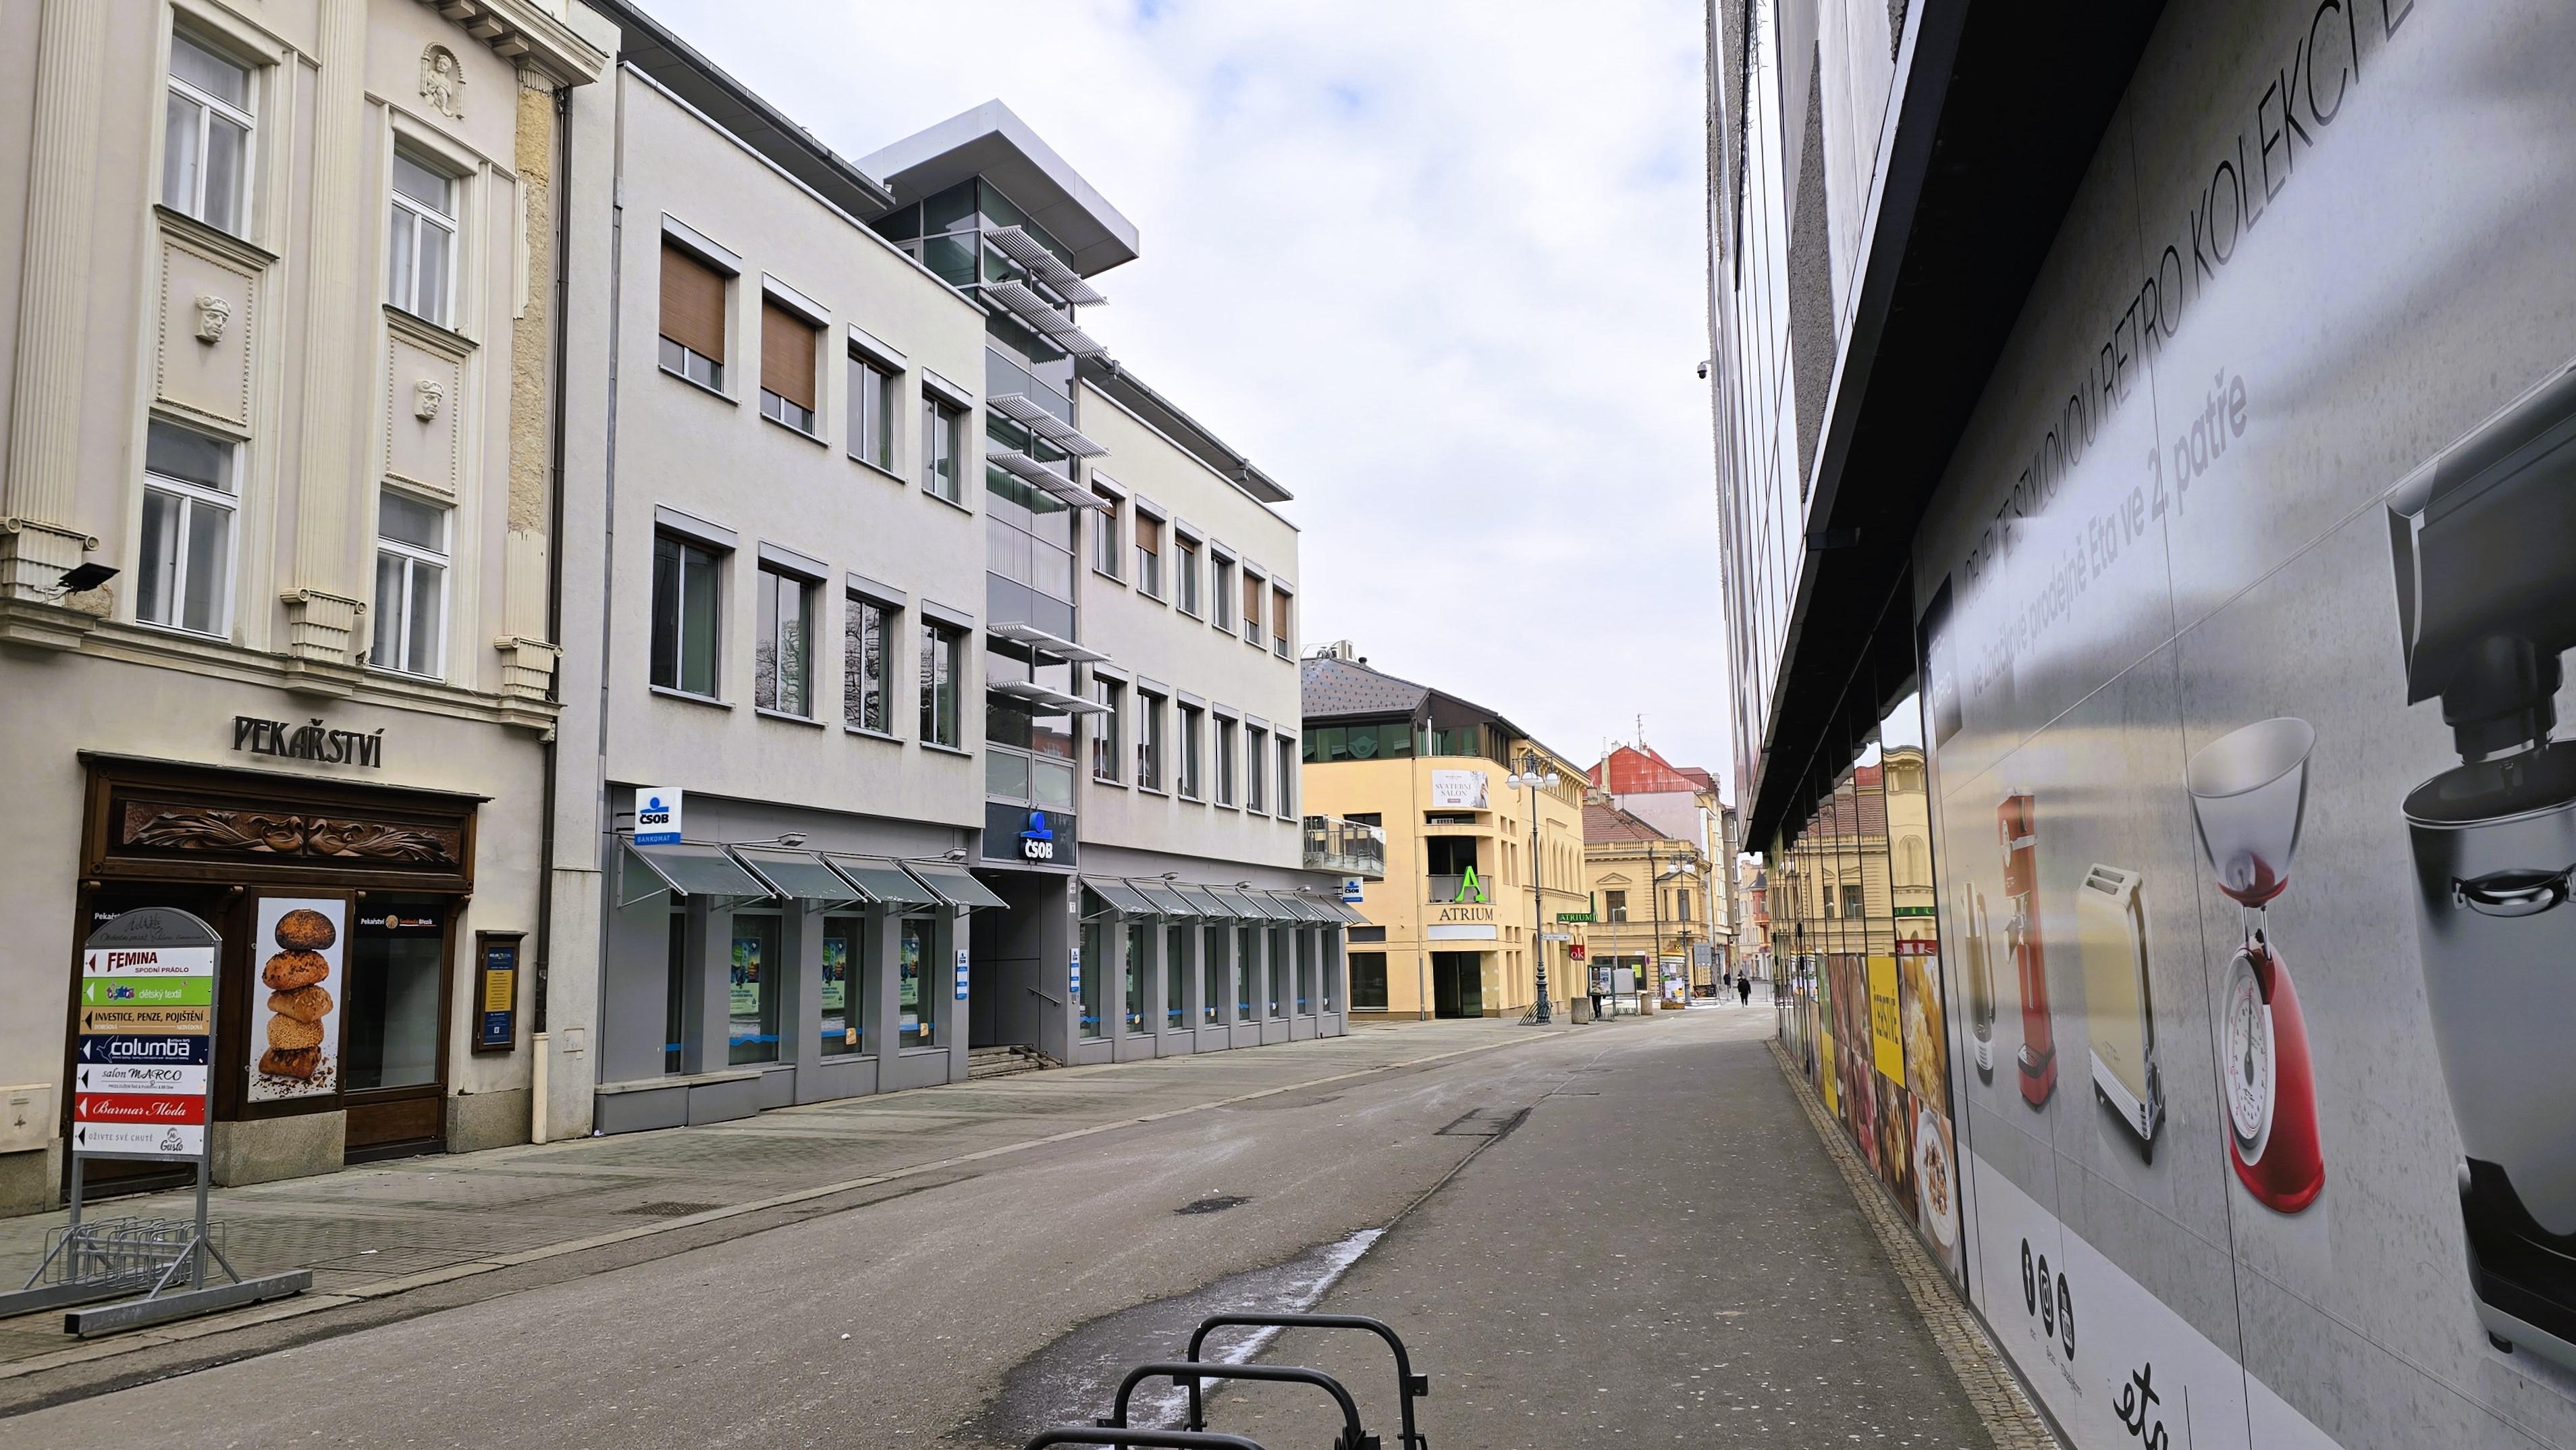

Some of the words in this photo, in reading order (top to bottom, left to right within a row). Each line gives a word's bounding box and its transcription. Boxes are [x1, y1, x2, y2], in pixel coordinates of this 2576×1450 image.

[1965, 498, 2014, 610] OBJEVTE
[2014, 367, 2097, 543] STYLOVOU
[2101, 244, 2182, 424] RETRO
[2191, 0, 2359, 298] KOLEKCI
[2088, 513, 2118, 581] Eta
[2120, 486, 2145, 546] ve
[2147, 448, 2169, 522] 2.
[2173, 365, 2247, 516] patře
[232, 716, 385, 768] PEKAŘSTVÍ
[639, 814, 669, 824] ČSOB
[1025, 838, 1053, 859] ČSOB
[1455, 865, 1488, 902] A
[1439, 908, 1493, 921] ATRIUM
[1571, 948, 1584, 959] ok
[107, 952, 158, 972] FEMINA
[139, 989, 163, 1000] dětský
[165, 989, 182, 998] textil
[95, 1012, 134, 1022] INVESTICE,
[137, 1013, 163, 1022] PENZE,
[165, 1010, 204, 1023] POJIŠTĚNÍ
[111, 1038, 190, 1056] columba
[102, 1068, 126, 1078] salon
[128, 1068, 182, 1080] MARCO
[92, 1100, 144, 1115] Barmar
[146, 1102, 187, 1116] Móda
[88, 1132, 113, 1141] OŽIVTE
[115, 1133, 128, 1142] SVÉ
[160, 1139, 183, 1152] Gusto
[2113, 1362, 2168, 1450] eta
